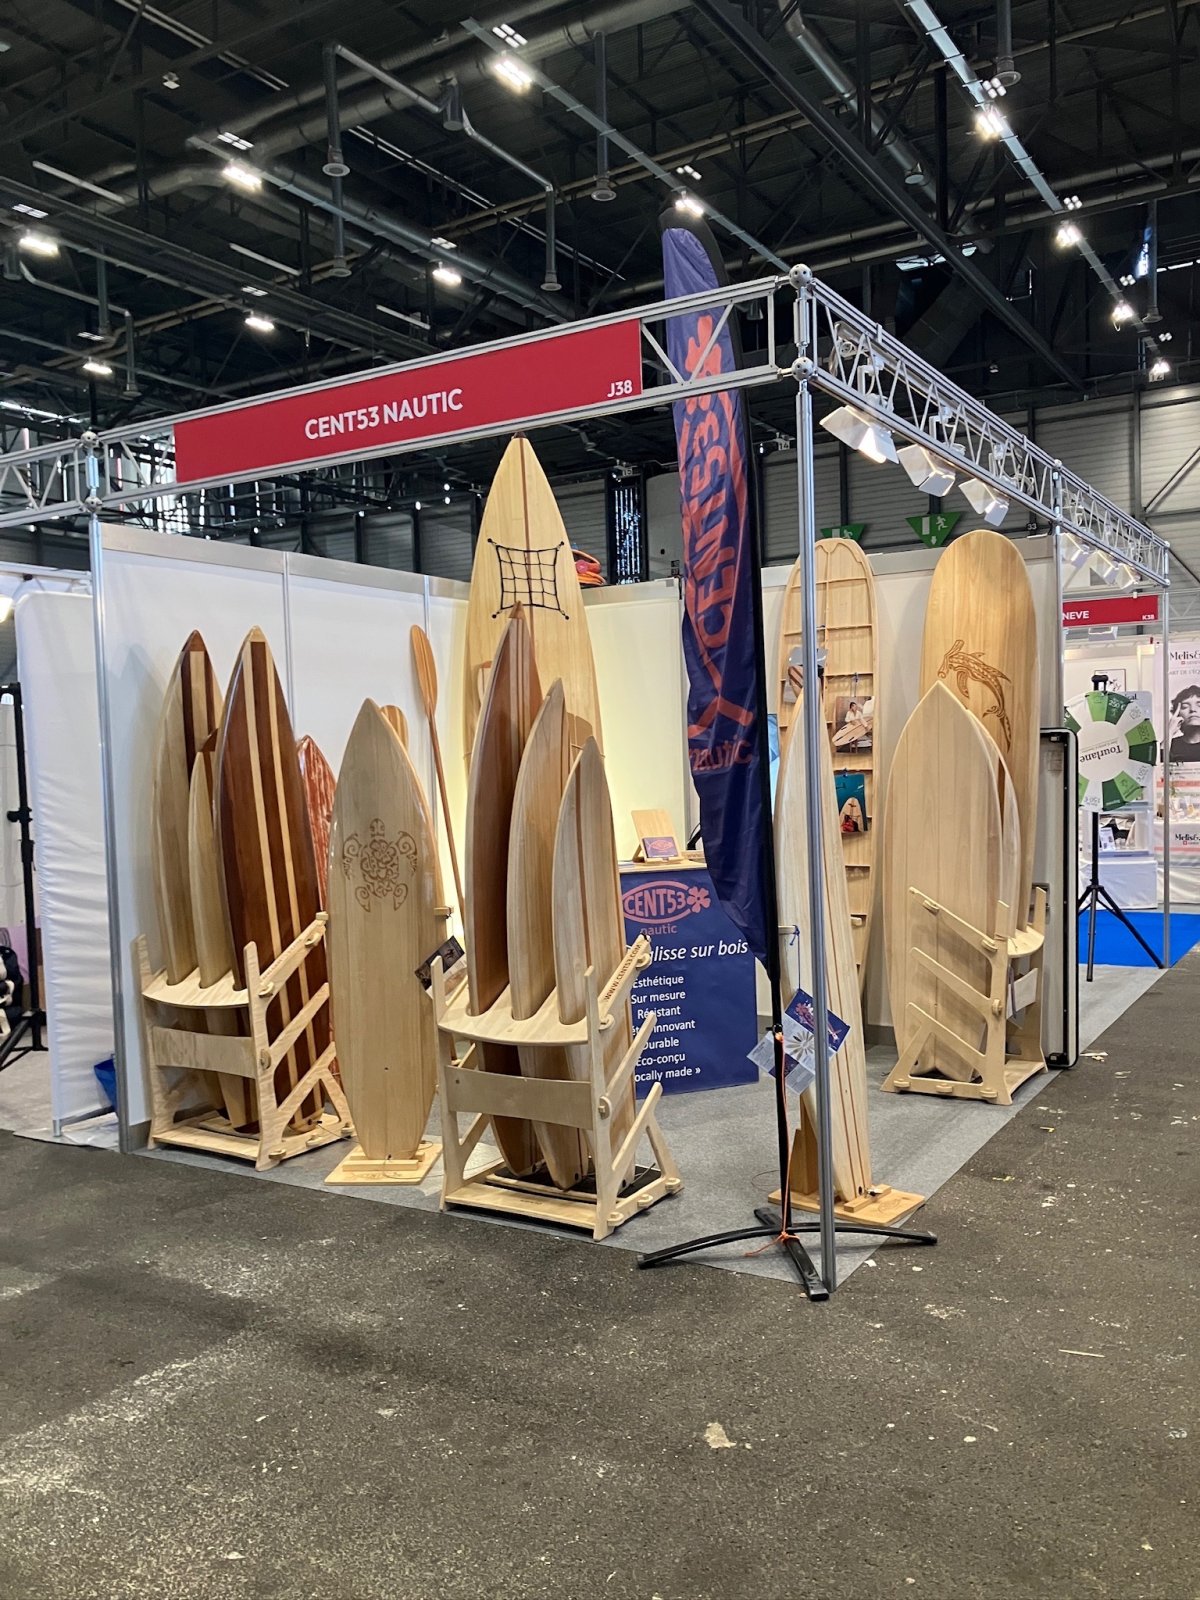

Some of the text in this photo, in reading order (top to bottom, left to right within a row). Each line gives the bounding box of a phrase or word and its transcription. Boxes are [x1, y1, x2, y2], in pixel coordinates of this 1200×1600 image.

[607, 380, 633, 398] J38
[305, 388, 463, 440] CENT53 NAUTIC
[690, 411, 735, 649] CENT53
[1079, 745, 1123, 763] Tourlane
[624, 889, 686, 917] CENT53
[640, 924, 678, 936] nautic
[690, 945, 715, 958] sur
[718, 939, 749, 955] bois
[631, 991, 686, 1005] Sur mesure
[634, 1070, 663, 1082] ocally
[665, 1066, 693, 1079] made
